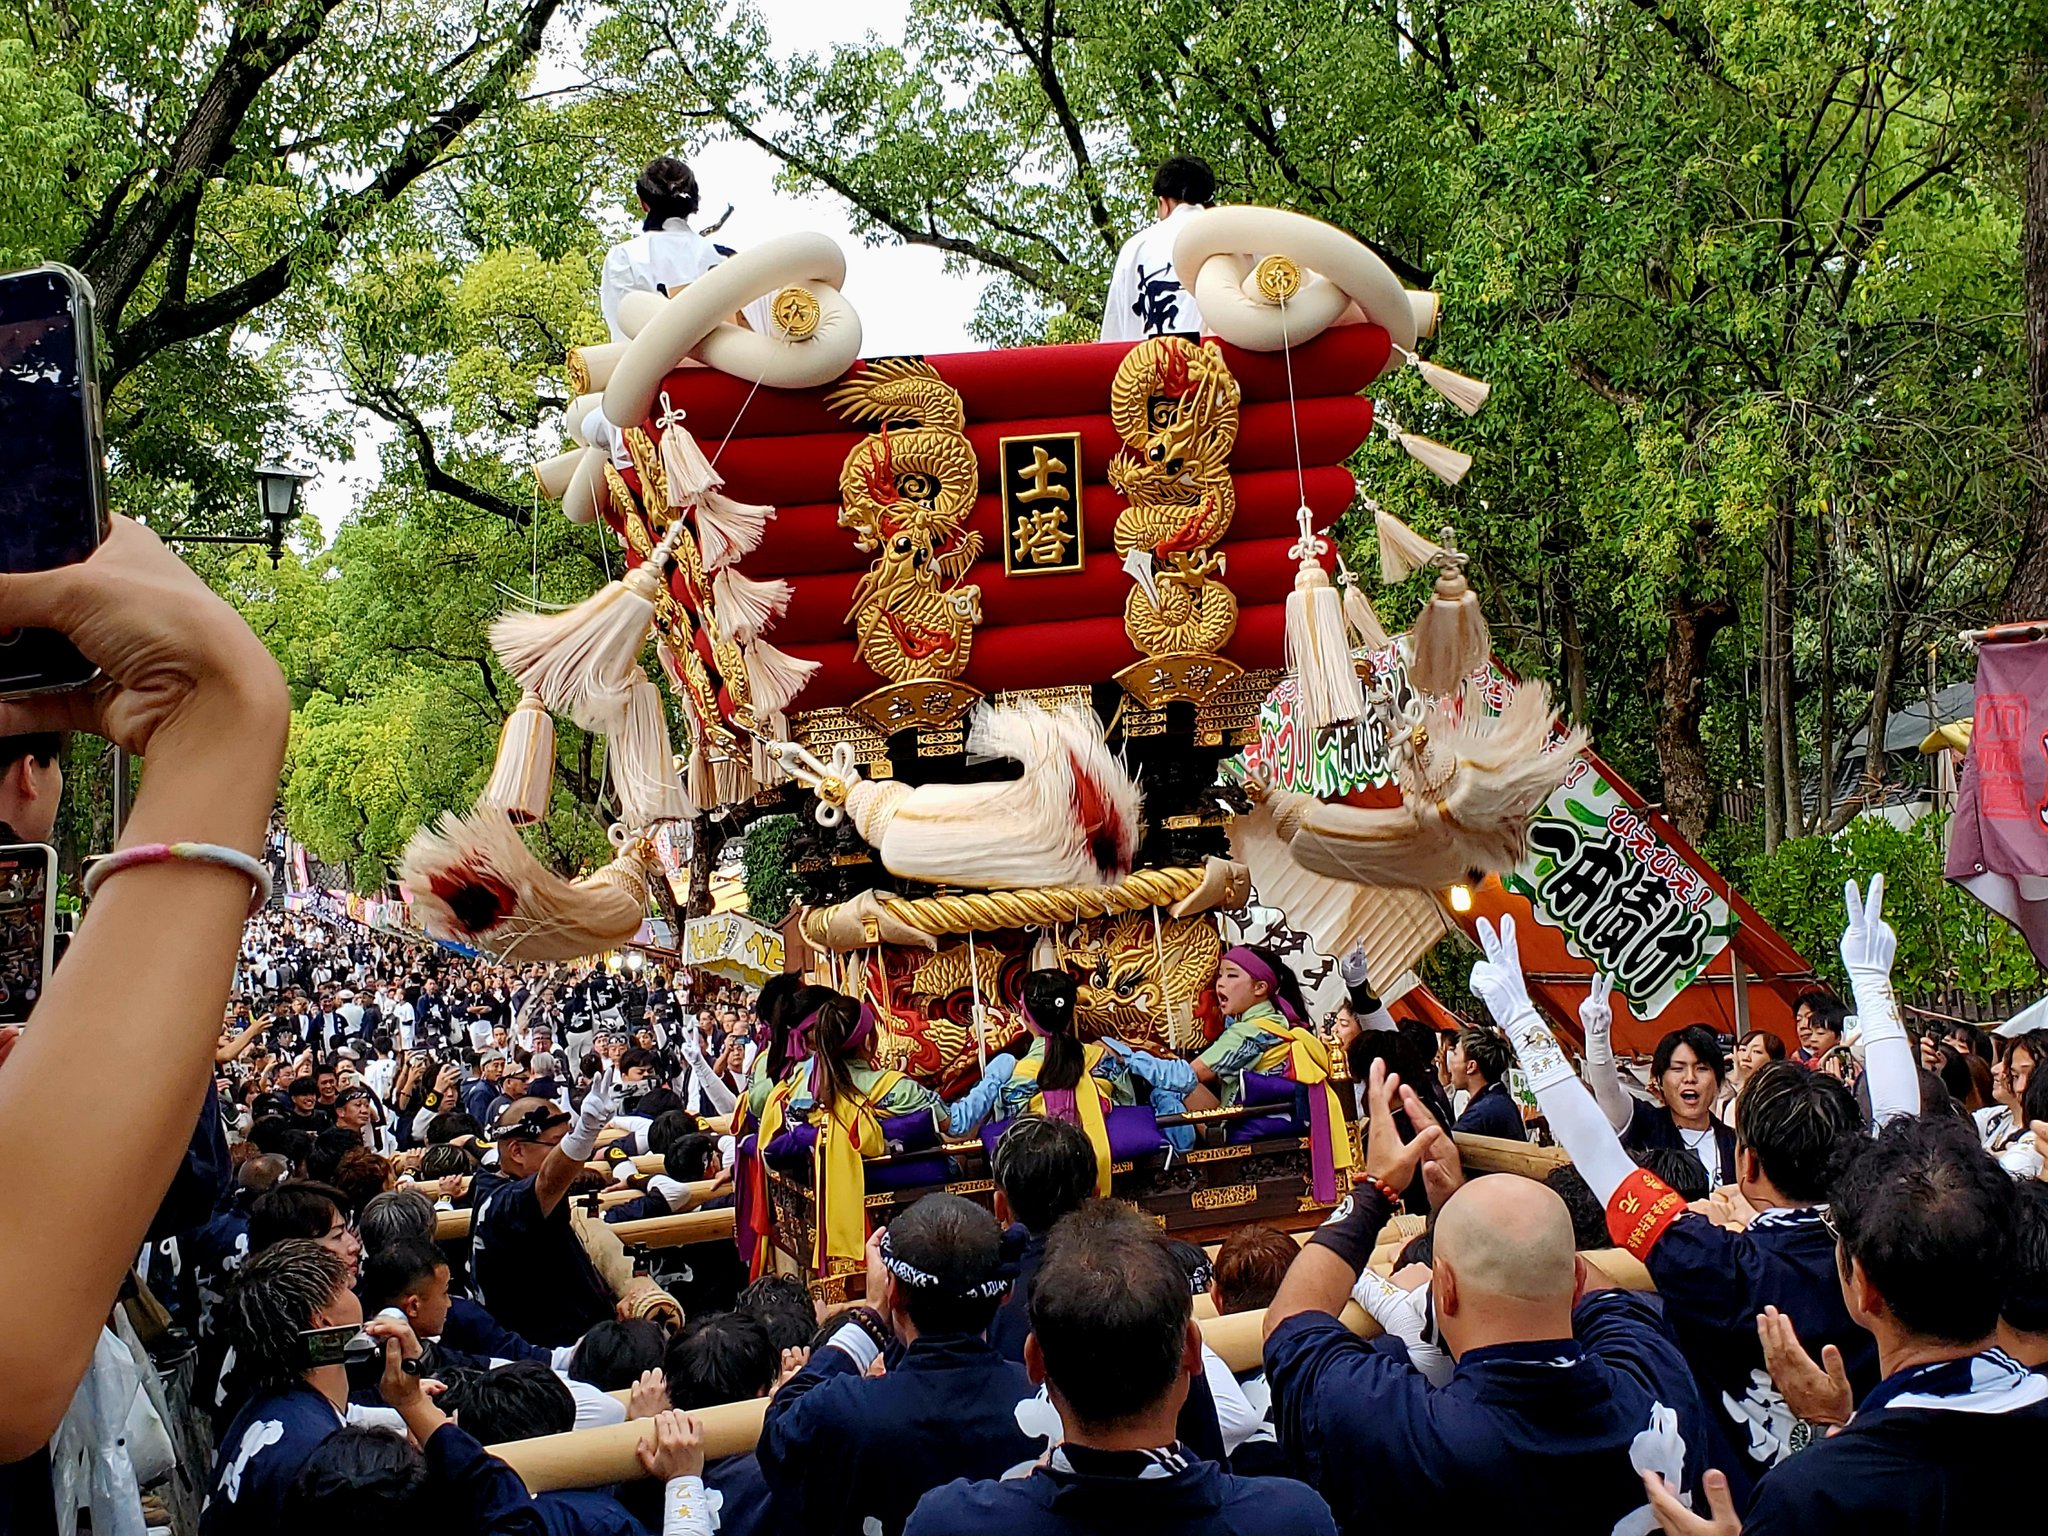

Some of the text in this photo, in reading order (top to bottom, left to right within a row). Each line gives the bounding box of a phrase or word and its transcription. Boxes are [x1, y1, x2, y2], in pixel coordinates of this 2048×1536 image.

[1011, 445, 1076, 564] 土塔
[1528, 823, 1707, 997] 一本漬け
[1606, 806, 1713, 914] ひえひえ!
